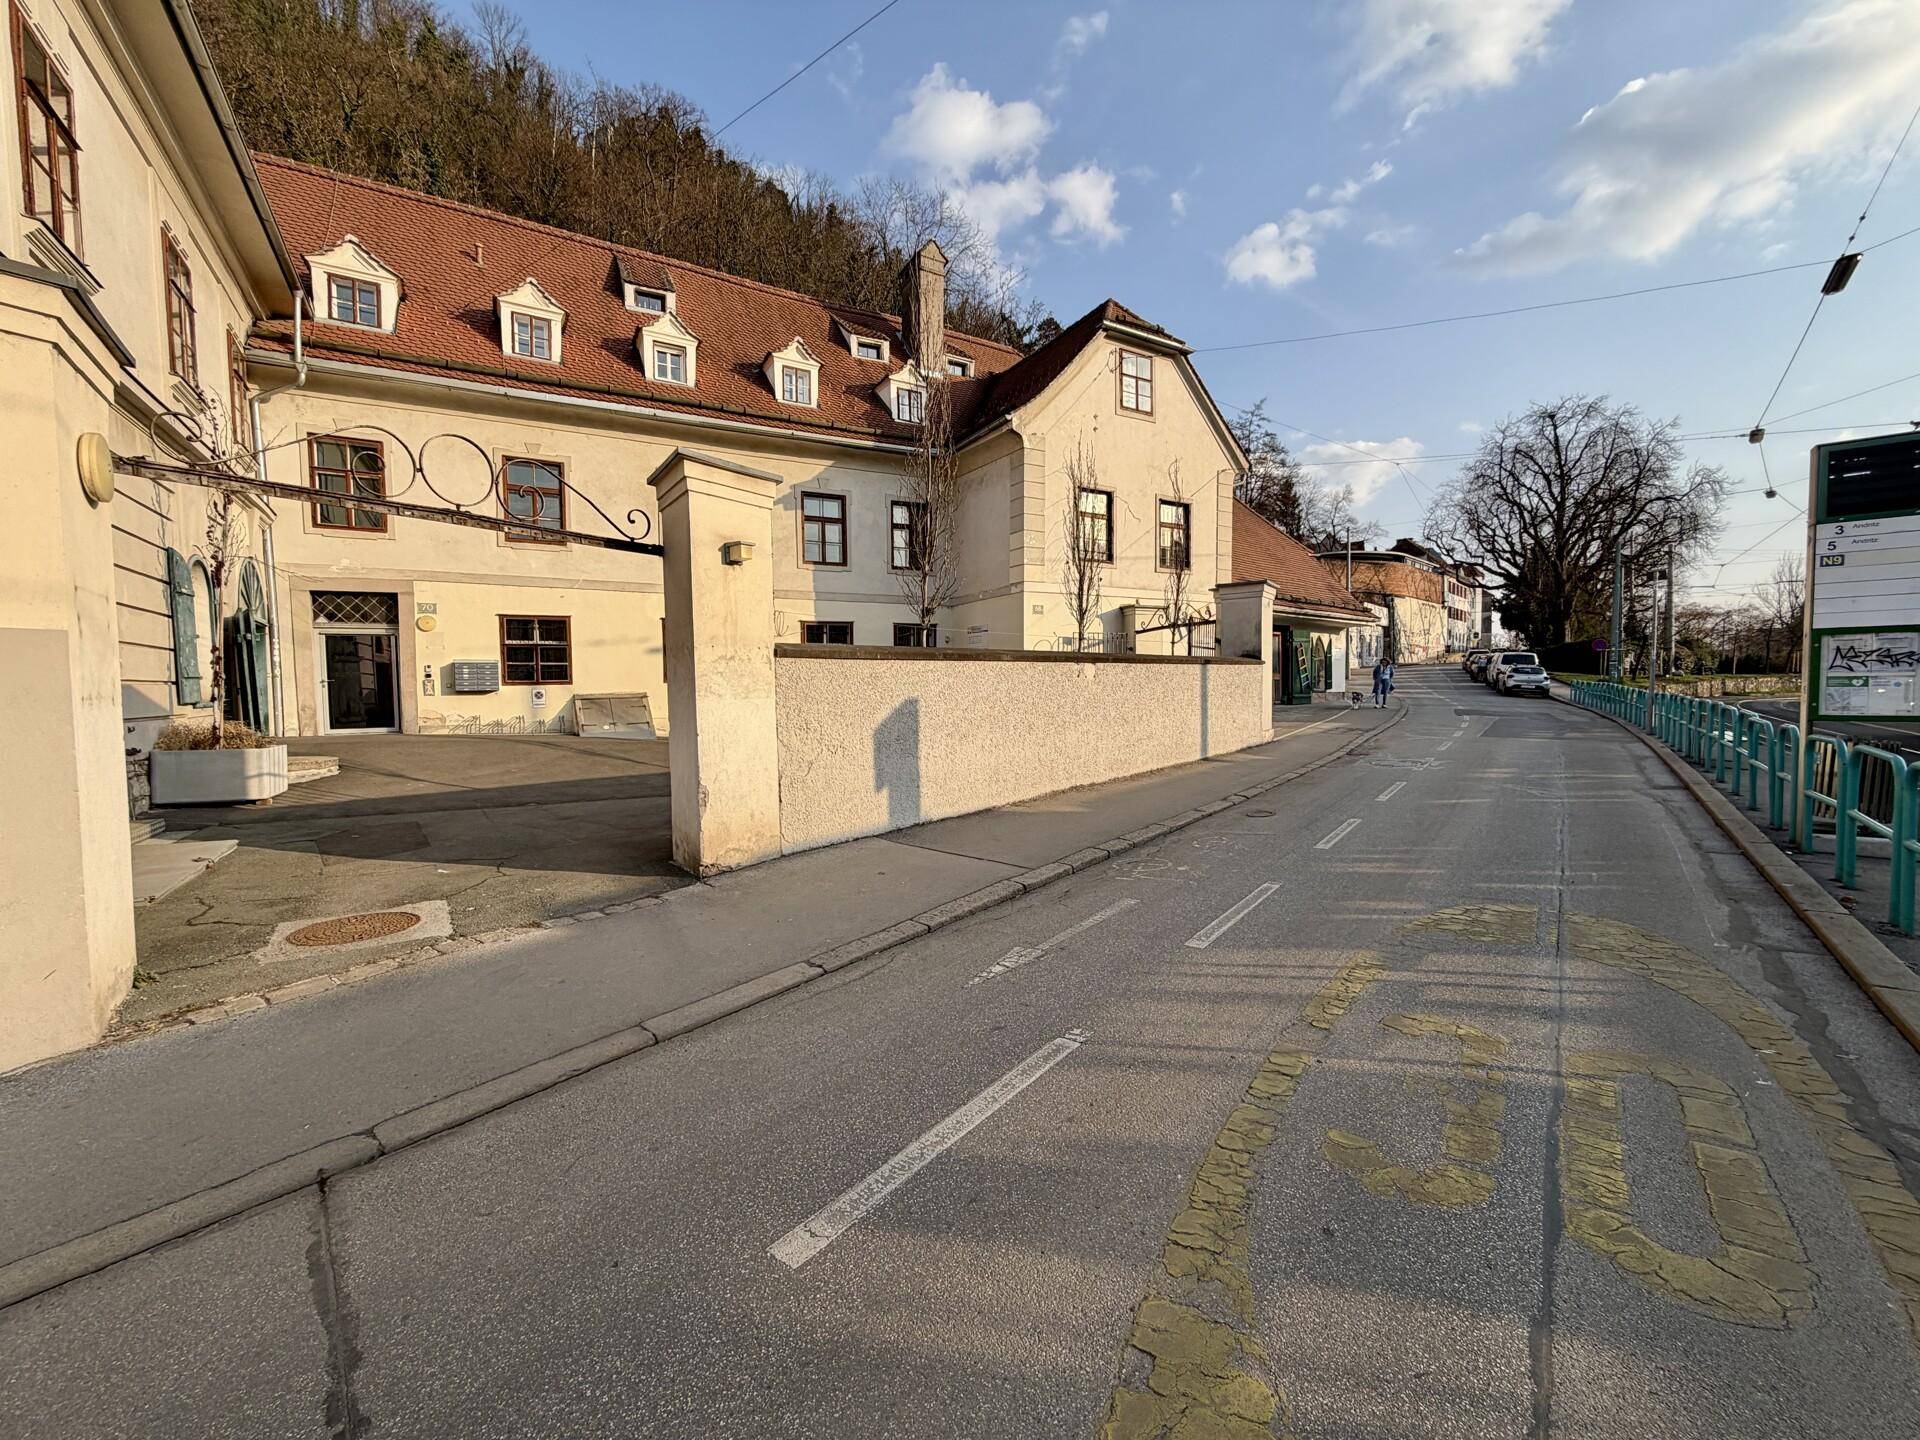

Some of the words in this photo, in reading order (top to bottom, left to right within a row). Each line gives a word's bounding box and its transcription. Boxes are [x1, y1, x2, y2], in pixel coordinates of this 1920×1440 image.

[1834, 525, 1844, 535] 3
[1827, 541, 1837, 551] 5
[1822, 556, 1842, 566] N9
[1322, 1011, 1816, 1325] 30
